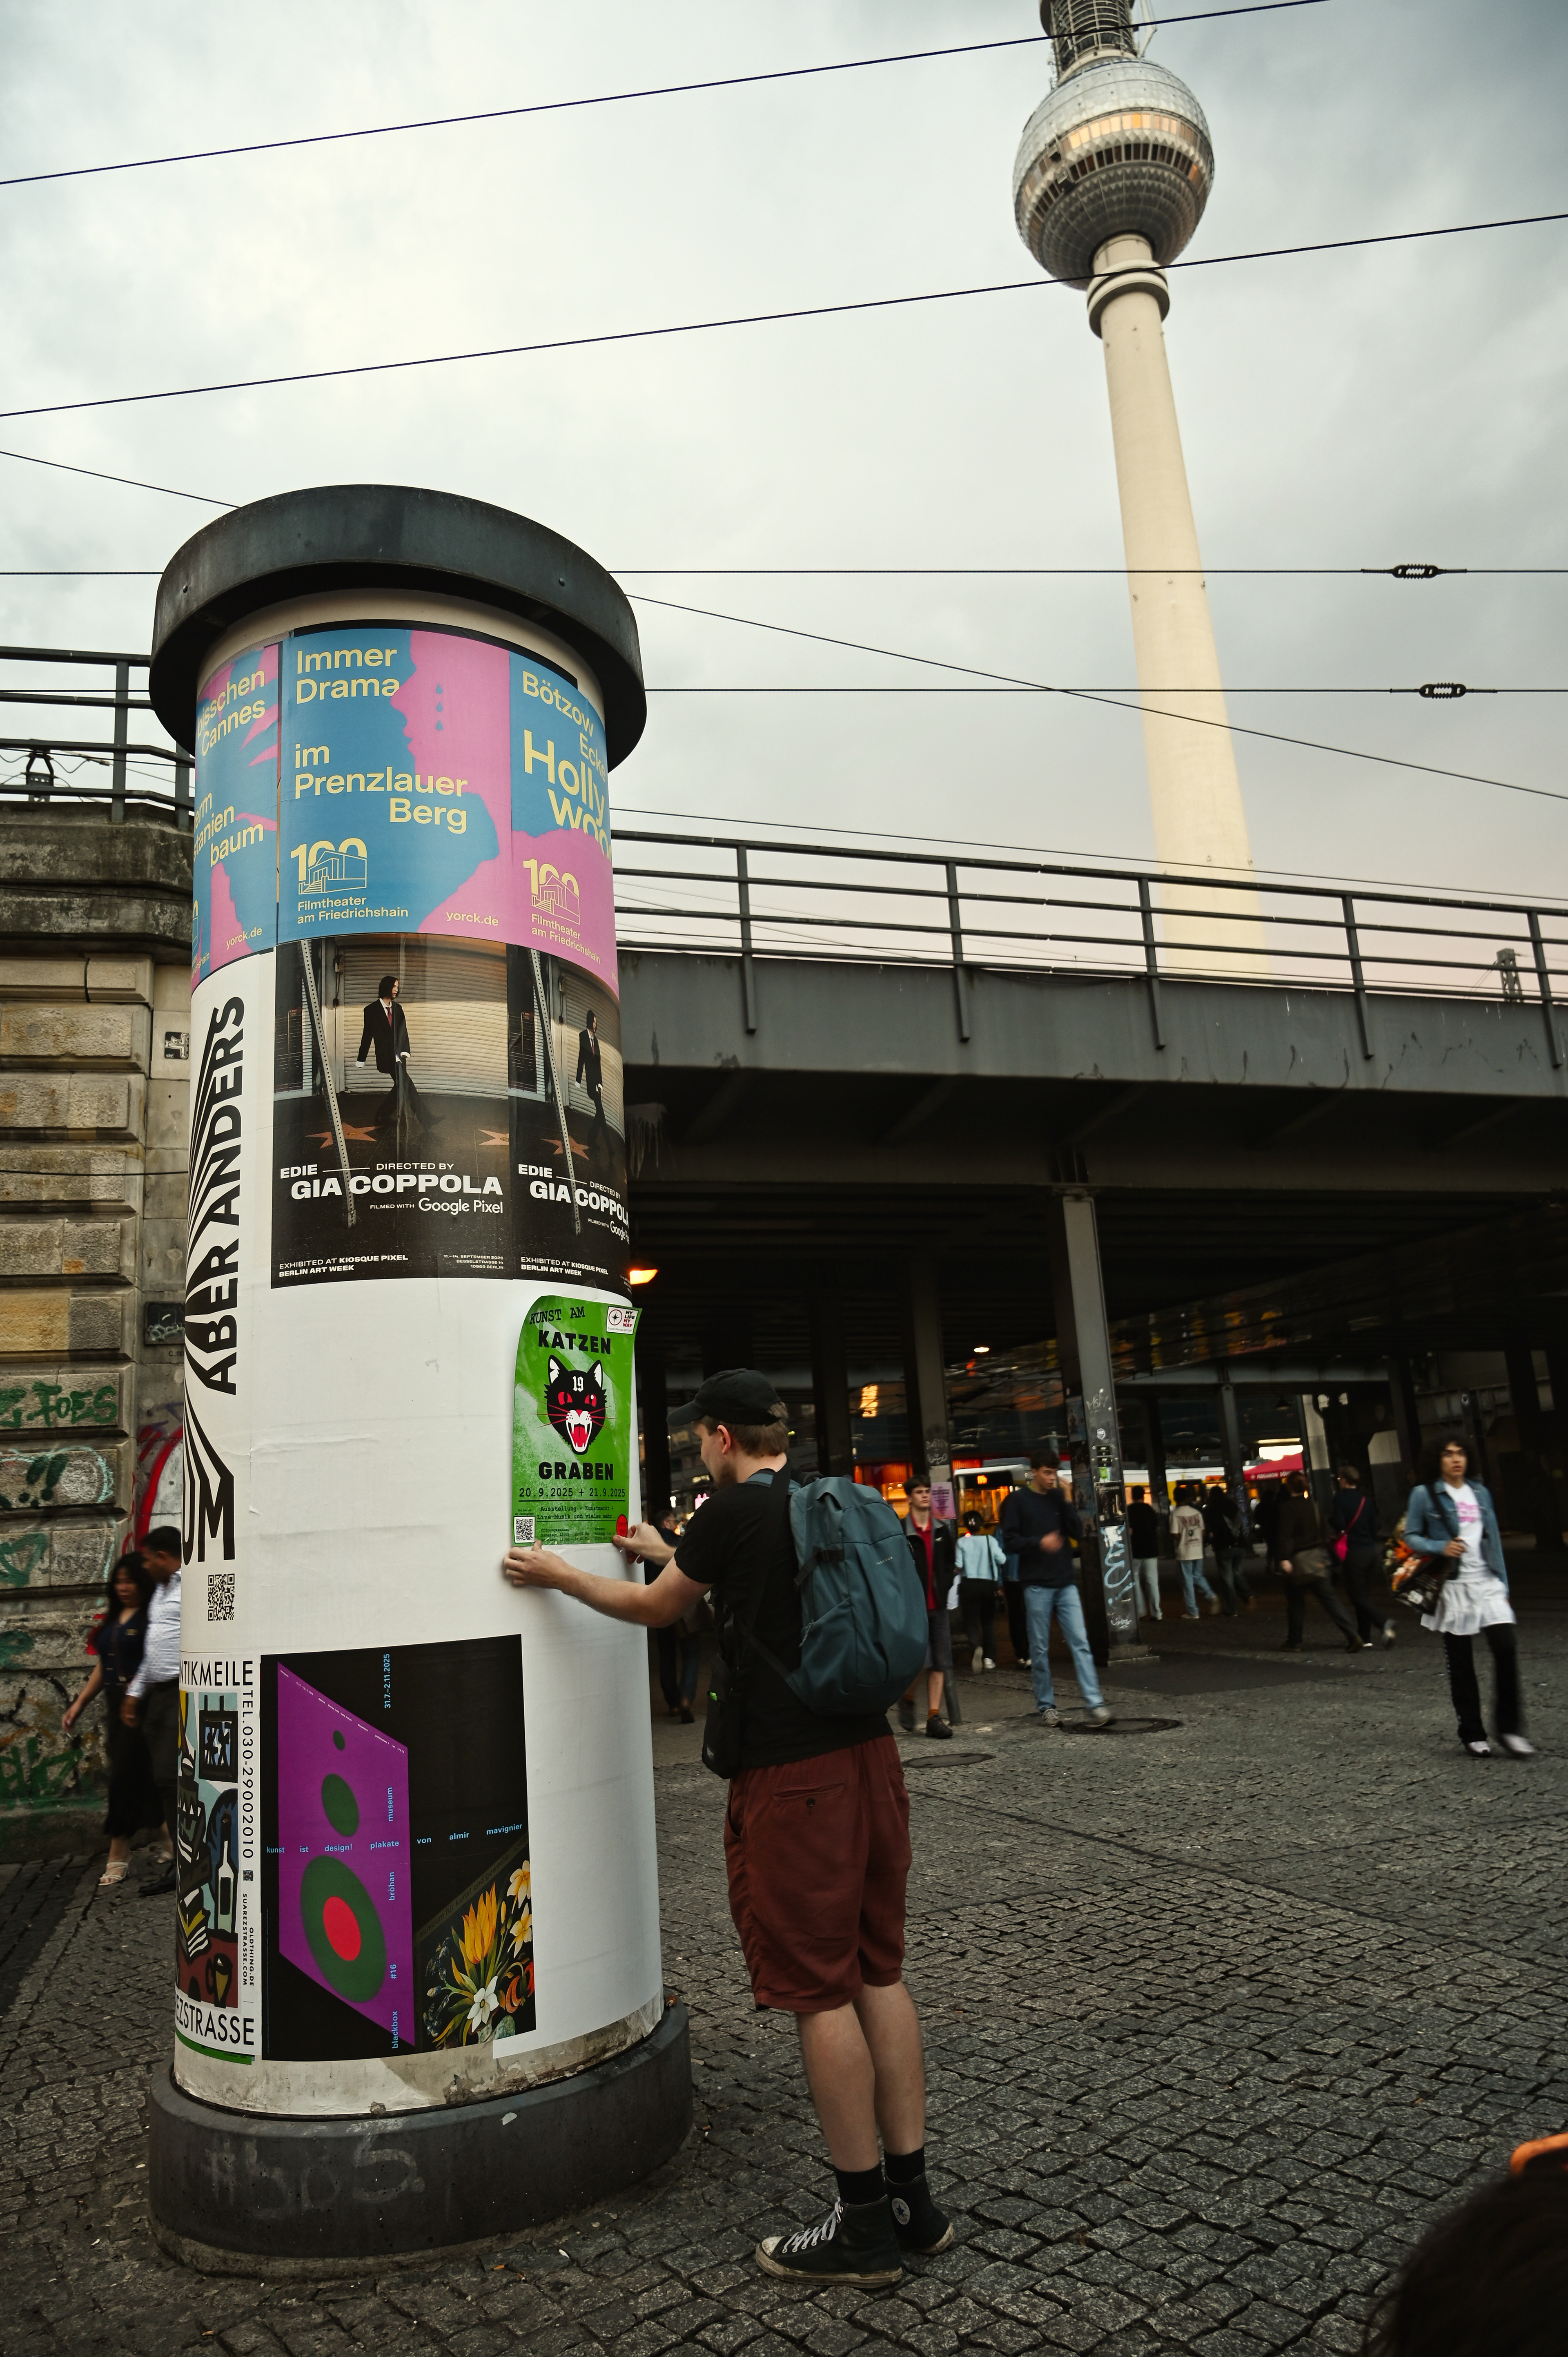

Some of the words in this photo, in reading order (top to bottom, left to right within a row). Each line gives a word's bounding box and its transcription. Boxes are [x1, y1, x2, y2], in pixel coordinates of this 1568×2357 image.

[297, 648, 397, 675] Immer
[198, 670, 265, 740] bisschen
[296, 678, 400, 705] Drama
[522, 670, 594, 737] Bötzow
[202, 699, 265, 757] Cannes
[295, 743, 330, 769] im
[579, 733, 606, 783] Ecke
[295, 767, 468, 799] Prenzlauer
[523, 729, 606, 827] Holly
[194, 792, 212, 834] erm
[390, 798, 468, 834] Berg
[210, 823, 263, 867] baum
[297, 914, 314, 925] am
[318, 906, 409, 923] Friedrichshain
[298, 896, 367, 912] Filmtheater
[446, 910, 499, 927] yorck.de
[531, 913, 581, 941] Filmtheater
[226, 927, 262, 950] yorck.de
[531, 927, 547, 938] am
[550, 932, 601, 964] Friedrichshain
[200, 997, 245, 1226] ANDERS
[280, 1164, 318, 1179] EDIE
[518, 1164, 552, 1178] EDIE
[590, 1181, 615, 1196] DIRECTED
[291, 1177, 342, 1200] GIA
[349, 1174, 503, 1195] COPPOLA
[530, 1180, 571, 1203] GIA
[418, 1197, 470, 1215] Google
[474, 1200, 503, 1213] Pixel
[610, 1220, 626, 1241] Google
[279, 1259, 323, 1269] EXHIBITED
[279, 1268, 308, 1278] BERLIN
[521, 1256, 560, 1267] EXHIBITED
[571, 1262, 595, 1272] KIOSQUE
[595, 1266, 609, 1275] PIXEL
[200, 1239, 239, 1395] ABER
[529, 1308, 562, 1325] KUNST
[570, 1306, 586, 1319] AM
[538, 1329, 611, 1355] KATZEN
[572, 1375, 584, 1392] 19
[538, 1461, 613, 1481] GRABEN
[519, 1487, 573, 1498] 20.9.2025
[589, 1488, 626, 1497] 21.9.2025
[266, 1846, 285, 1854] kunst
[299, 1844, 309, 1853] ist
[324, 1843, 353, 1855] design!
[370, 1839, 400, 1851] plakate
[449, 1831, 470, 1840] almir
[486, 1824, 523, 1835] mavignier
[419, 1913, 445, 1938] museum
[445, 1903, 454, 1915] für
[455, 1891, 472, 1905] kunst
[473, 1876, 484, 1890] und
[485, 1854, 509, 1880] gewerbe
[176, 1992, 254, 2046] EZSTRASSE
